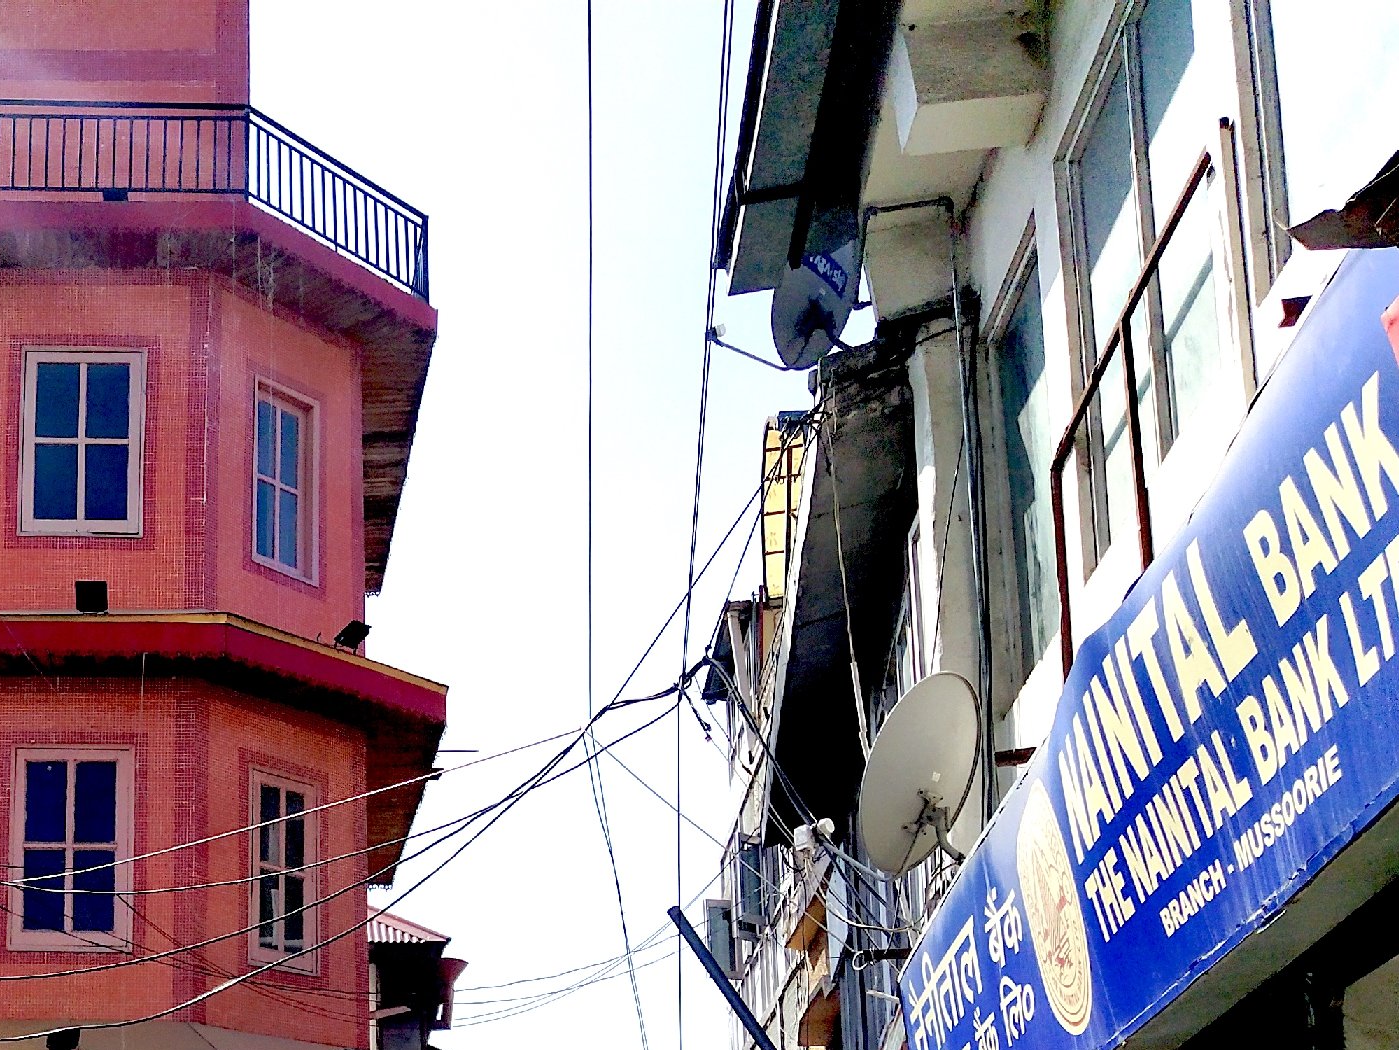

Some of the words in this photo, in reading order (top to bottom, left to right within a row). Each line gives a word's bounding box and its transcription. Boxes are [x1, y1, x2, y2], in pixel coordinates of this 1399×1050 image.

[1058, 536, 1258, 865] NAINITAL
[1242, 370, 1399, 628] BANK
[1085, 847, 1136, 942] THE
[1119, 730, 1253, 903] NAINITAL
[1236, 613, 1349, 785] BANK
[1338, 533, 1399, 687] LT
[984, 887, 1023, 968] बैंक
[1159, 859, 1227, 938] BRANCH
[1233, 744, 1343, 873] MUSSOORIE
